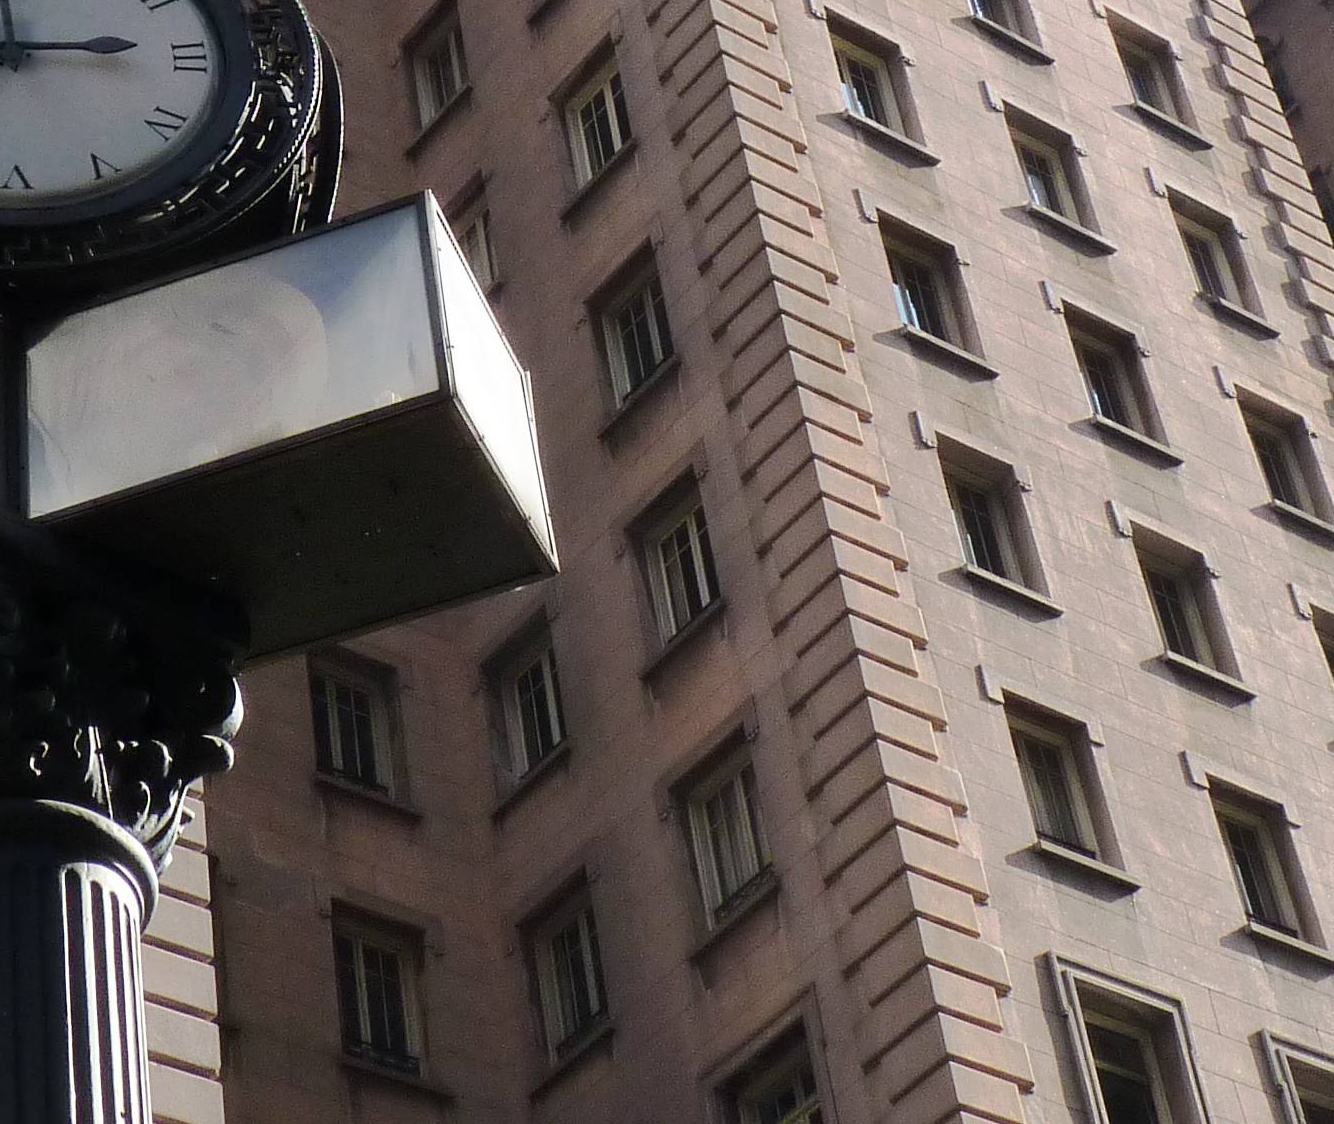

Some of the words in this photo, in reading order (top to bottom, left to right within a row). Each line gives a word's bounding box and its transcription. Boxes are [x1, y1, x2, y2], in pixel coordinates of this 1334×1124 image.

[171, 40, 208, 73] III
[144, 106, 190, 141] IV
[90, 152, 122, 180] V
